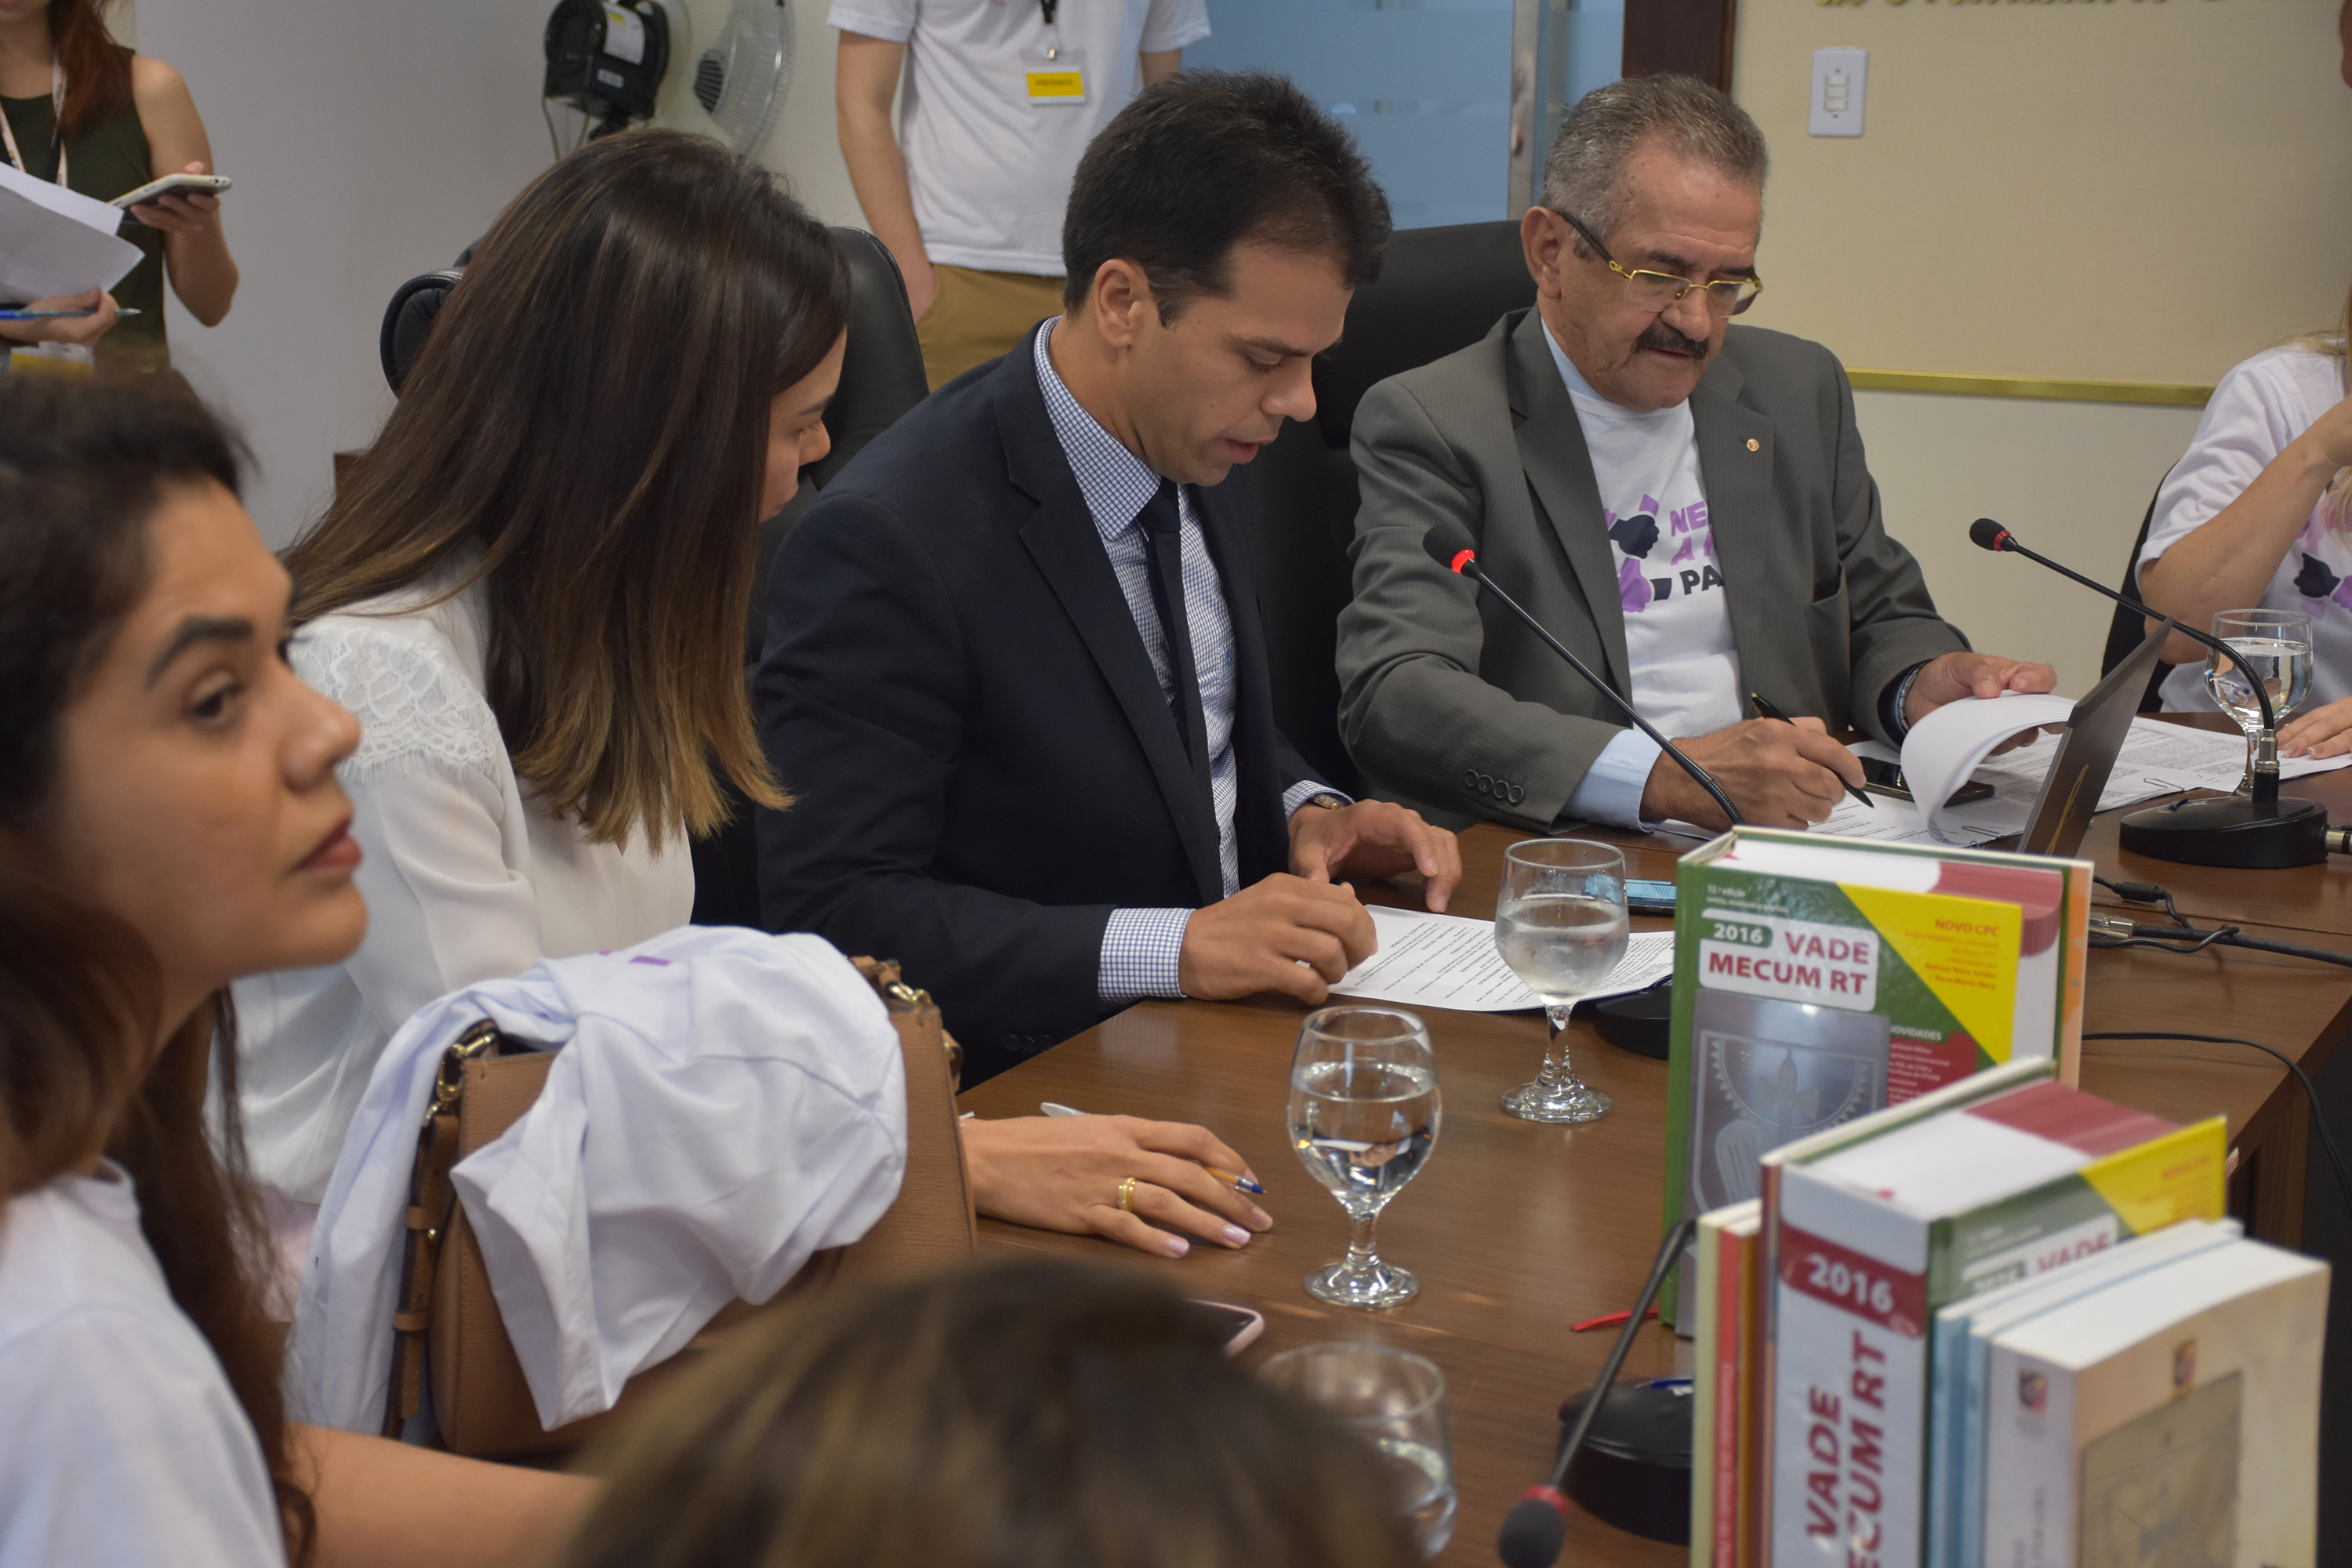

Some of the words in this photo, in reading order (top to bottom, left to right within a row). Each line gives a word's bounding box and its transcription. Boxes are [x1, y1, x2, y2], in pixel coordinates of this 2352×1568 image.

[1670, 501, 1707, 537] NE
[1713, 924, 1763, 944] 2016
[1785, 931, 1869, 964] VADE
[1935, 919, 1973, 933] NOVO
[1976, 924, 1999, 937] CPC
[1708, 952, 1821, 989] MECUM
[1830, 970, 1867, 995] RT
[1806, 1253, 1894, 1314] 2016
[1852, 1330, 1886, 1409] RT
[1807, 1385, 1841, 1538] VADE
[1848, 1416, 1883, 1568] ECUM
